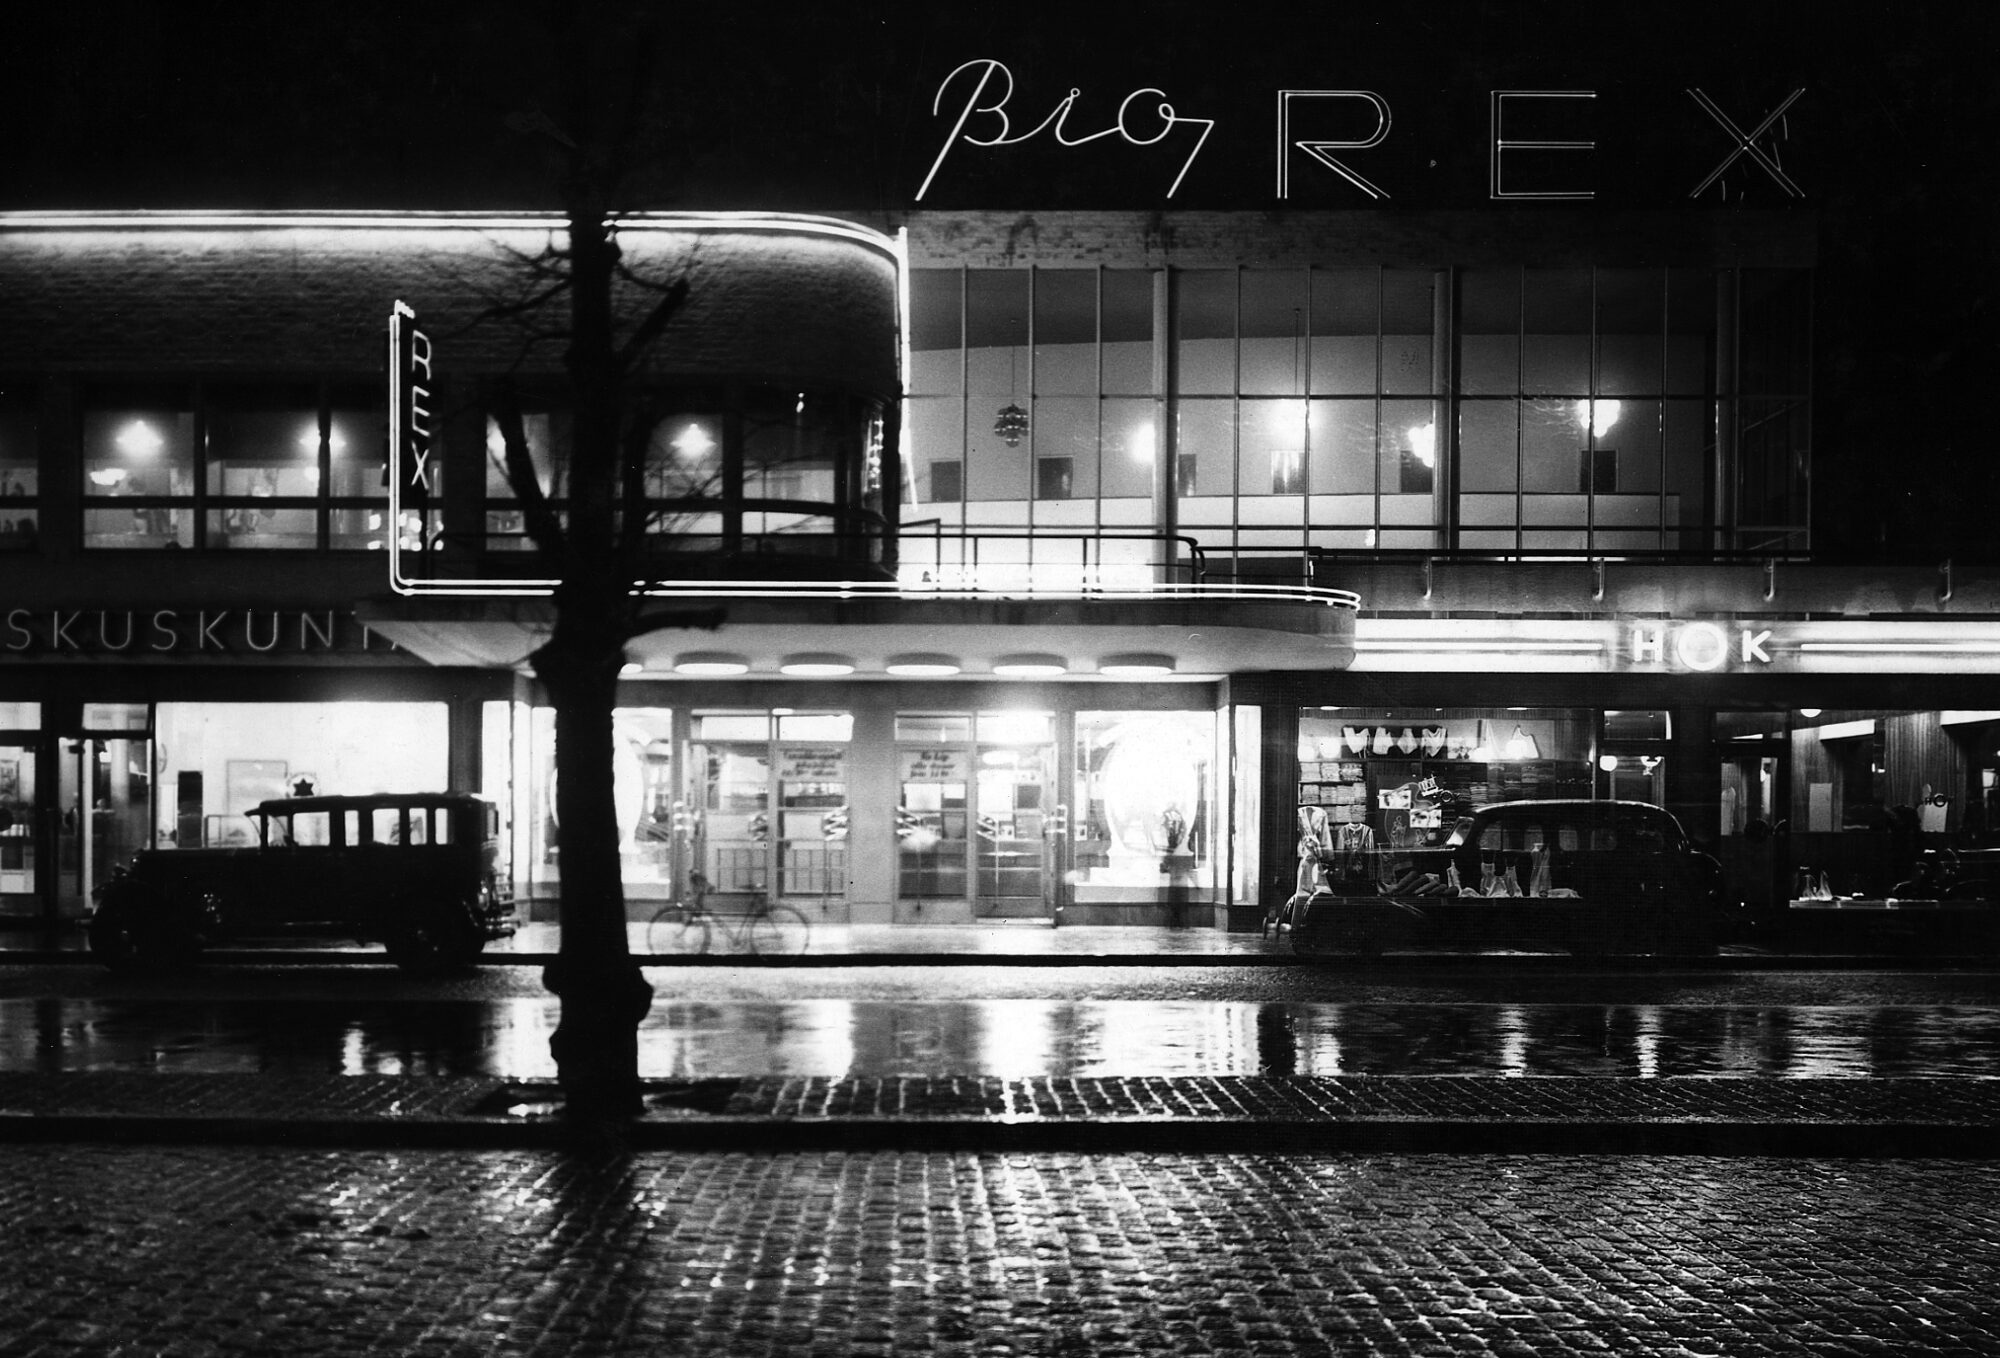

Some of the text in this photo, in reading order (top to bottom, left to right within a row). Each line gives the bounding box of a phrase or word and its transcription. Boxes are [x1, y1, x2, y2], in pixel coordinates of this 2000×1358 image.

[914, 58, 1807, 202] Bio REX
[411, 329, 432, 490] REX
[6, 608, 399, 652] SKUSKUN
[1634, 621, 1773, 672] HOK
